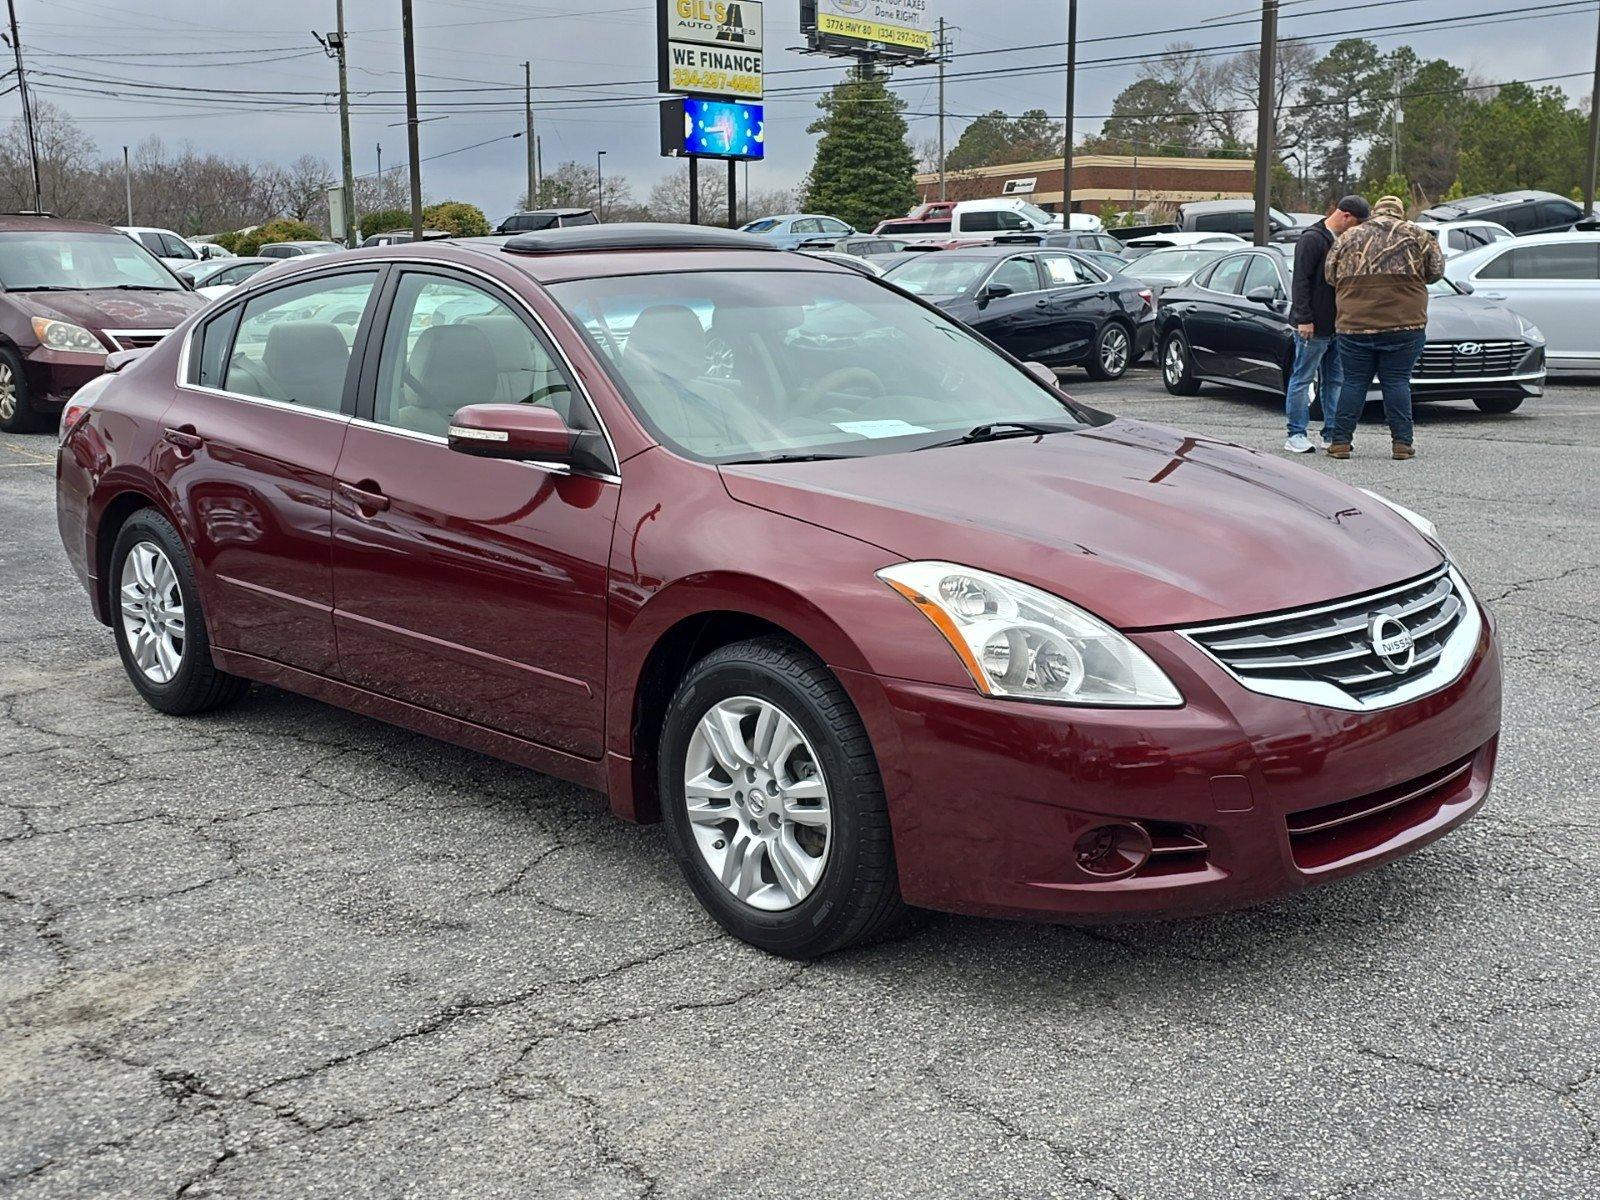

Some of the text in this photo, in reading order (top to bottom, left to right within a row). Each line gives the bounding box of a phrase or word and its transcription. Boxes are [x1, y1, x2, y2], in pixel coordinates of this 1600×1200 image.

[677, 0, 727, 23] GIL'S
[875, 5, 919, 23] Done RIGHT!
[677, 20, 756, 36] AUTO SALES
[826, 18, 928, 44] 3776 HWY 80 (334) 297-3209
[673, 48, 761, 73] WE FINANCE
